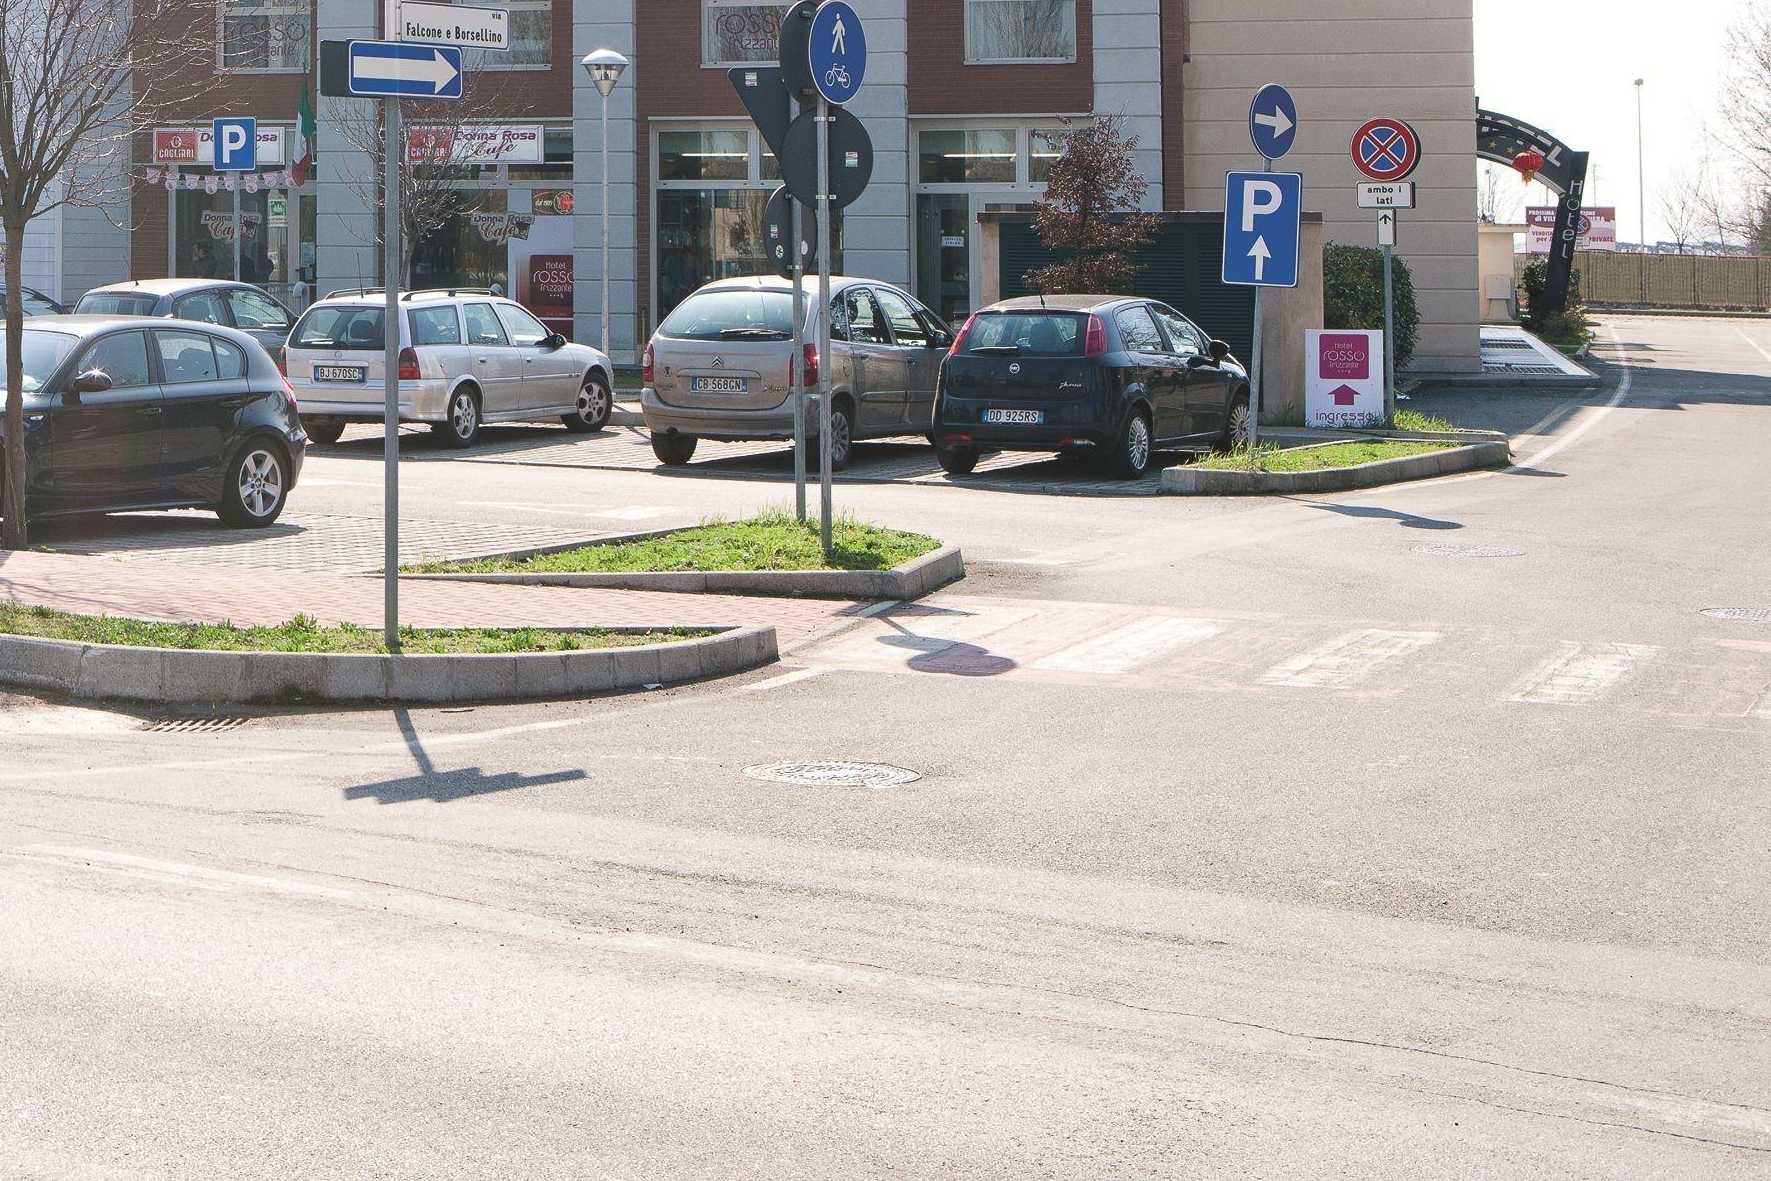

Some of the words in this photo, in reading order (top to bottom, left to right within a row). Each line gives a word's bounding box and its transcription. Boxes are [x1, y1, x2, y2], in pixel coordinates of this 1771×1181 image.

[491, 12, 502, 20] via
[715, 13, 781, 36] ross
[406, 22, 442, 38] Falcone
[446, 29, 452, 39] e
[454, 25, 502, 43] Borsellino
[728, 36, 778, 50] frizzant
[256, 132, 278, 142] osa
[501, 130, 537, 141] Rosa
[223, 124, 247, 164] P
[158, 148, 194, 159] CAGLIARI
[1367, 185, 1394, 194] ambo
[1398, 185, 1402, 194] i
[1241, 179, 1283, 232] P
[1376, 196, 1393, 205] lati
[474, 215, 504, 223] Donna
[508, 214, 533, 223] Rosa
[1334, 342, 1353, 350] Hotel
[320, 368, 330, 378] BJ
[697, 378, 708, 389] CB
[711, 378, 741, 391] 568GN
[989, 410, 1001, 421] DD
[1005, 410, 1038, 422] 925RS
[1316, 409, 1375, 424] ingresso
